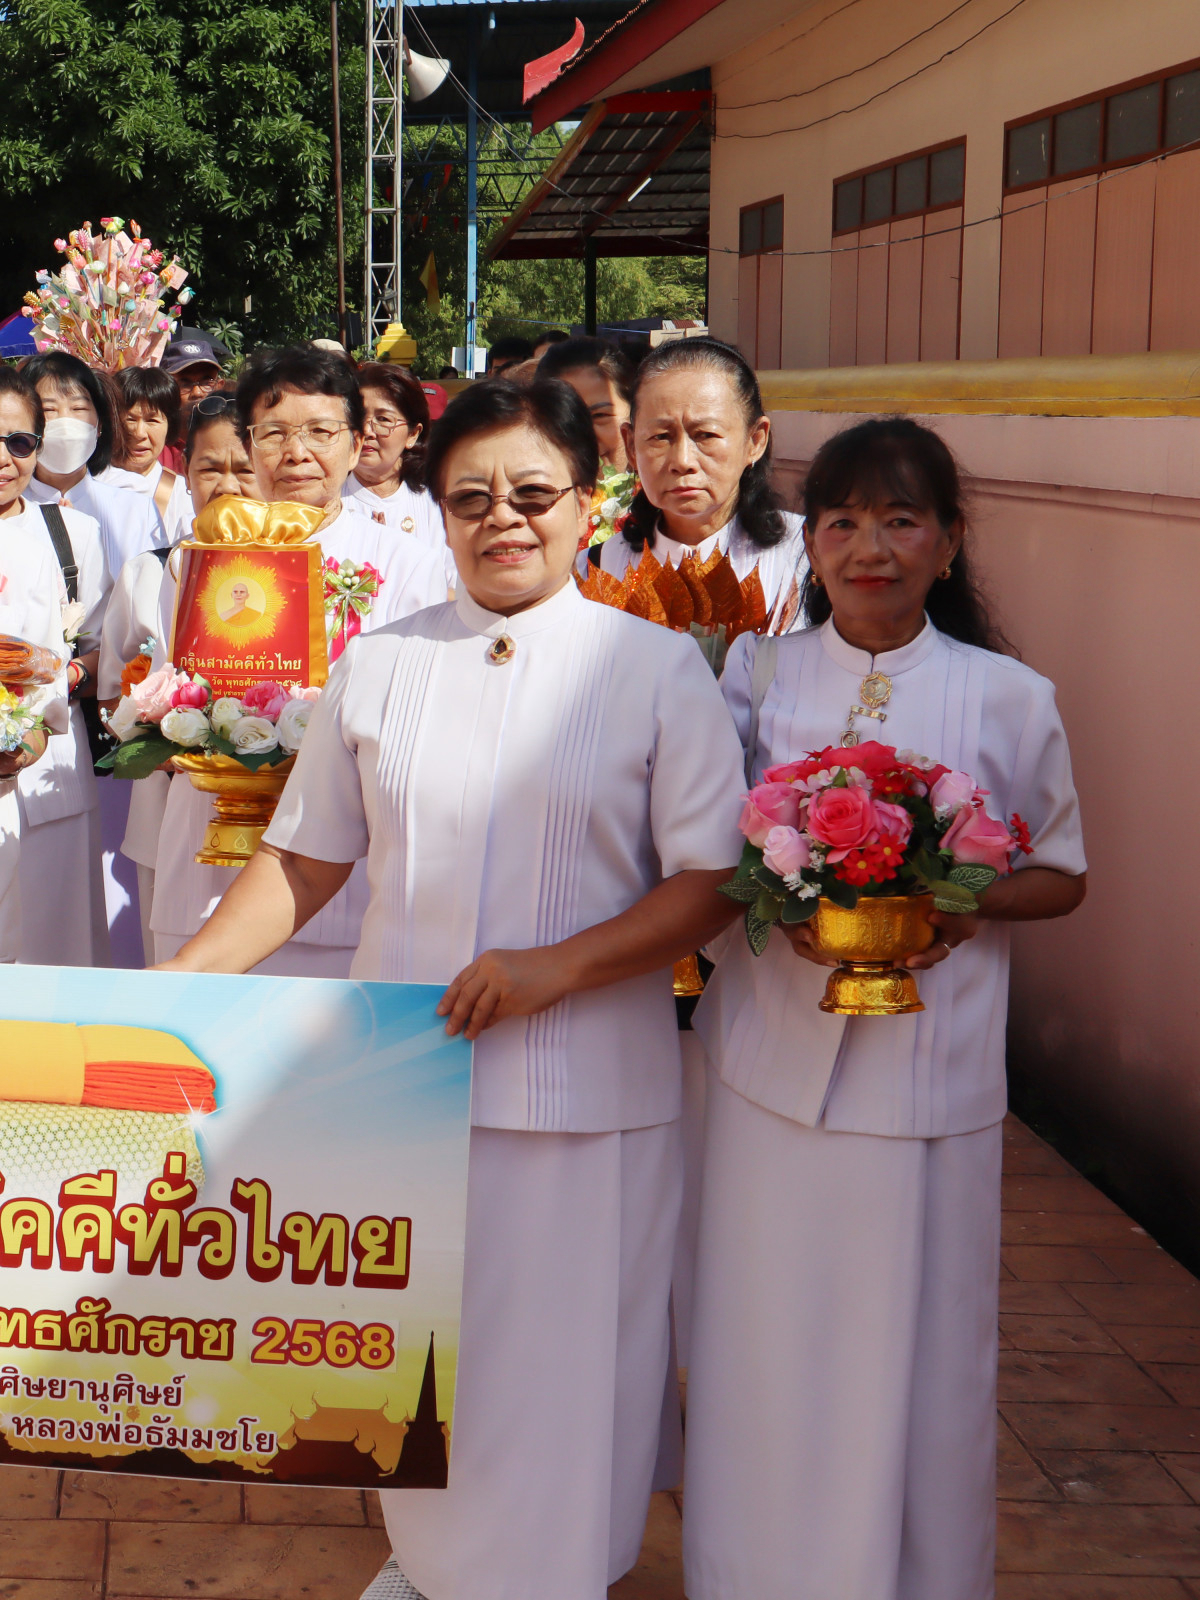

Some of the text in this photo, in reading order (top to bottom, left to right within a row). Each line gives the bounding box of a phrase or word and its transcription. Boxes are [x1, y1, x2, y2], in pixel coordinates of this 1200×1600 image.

[180, 651, 301, 672] กฐินสามัคคีทั่วไทย
[212, 676, 223, 685] วัด
[226, 677, 273, 688] พุทธศัก
[250, 1317, 395, 1370] 2568
[11, 1413, 277, 1452] หลวงพ่อธัมมชโย
